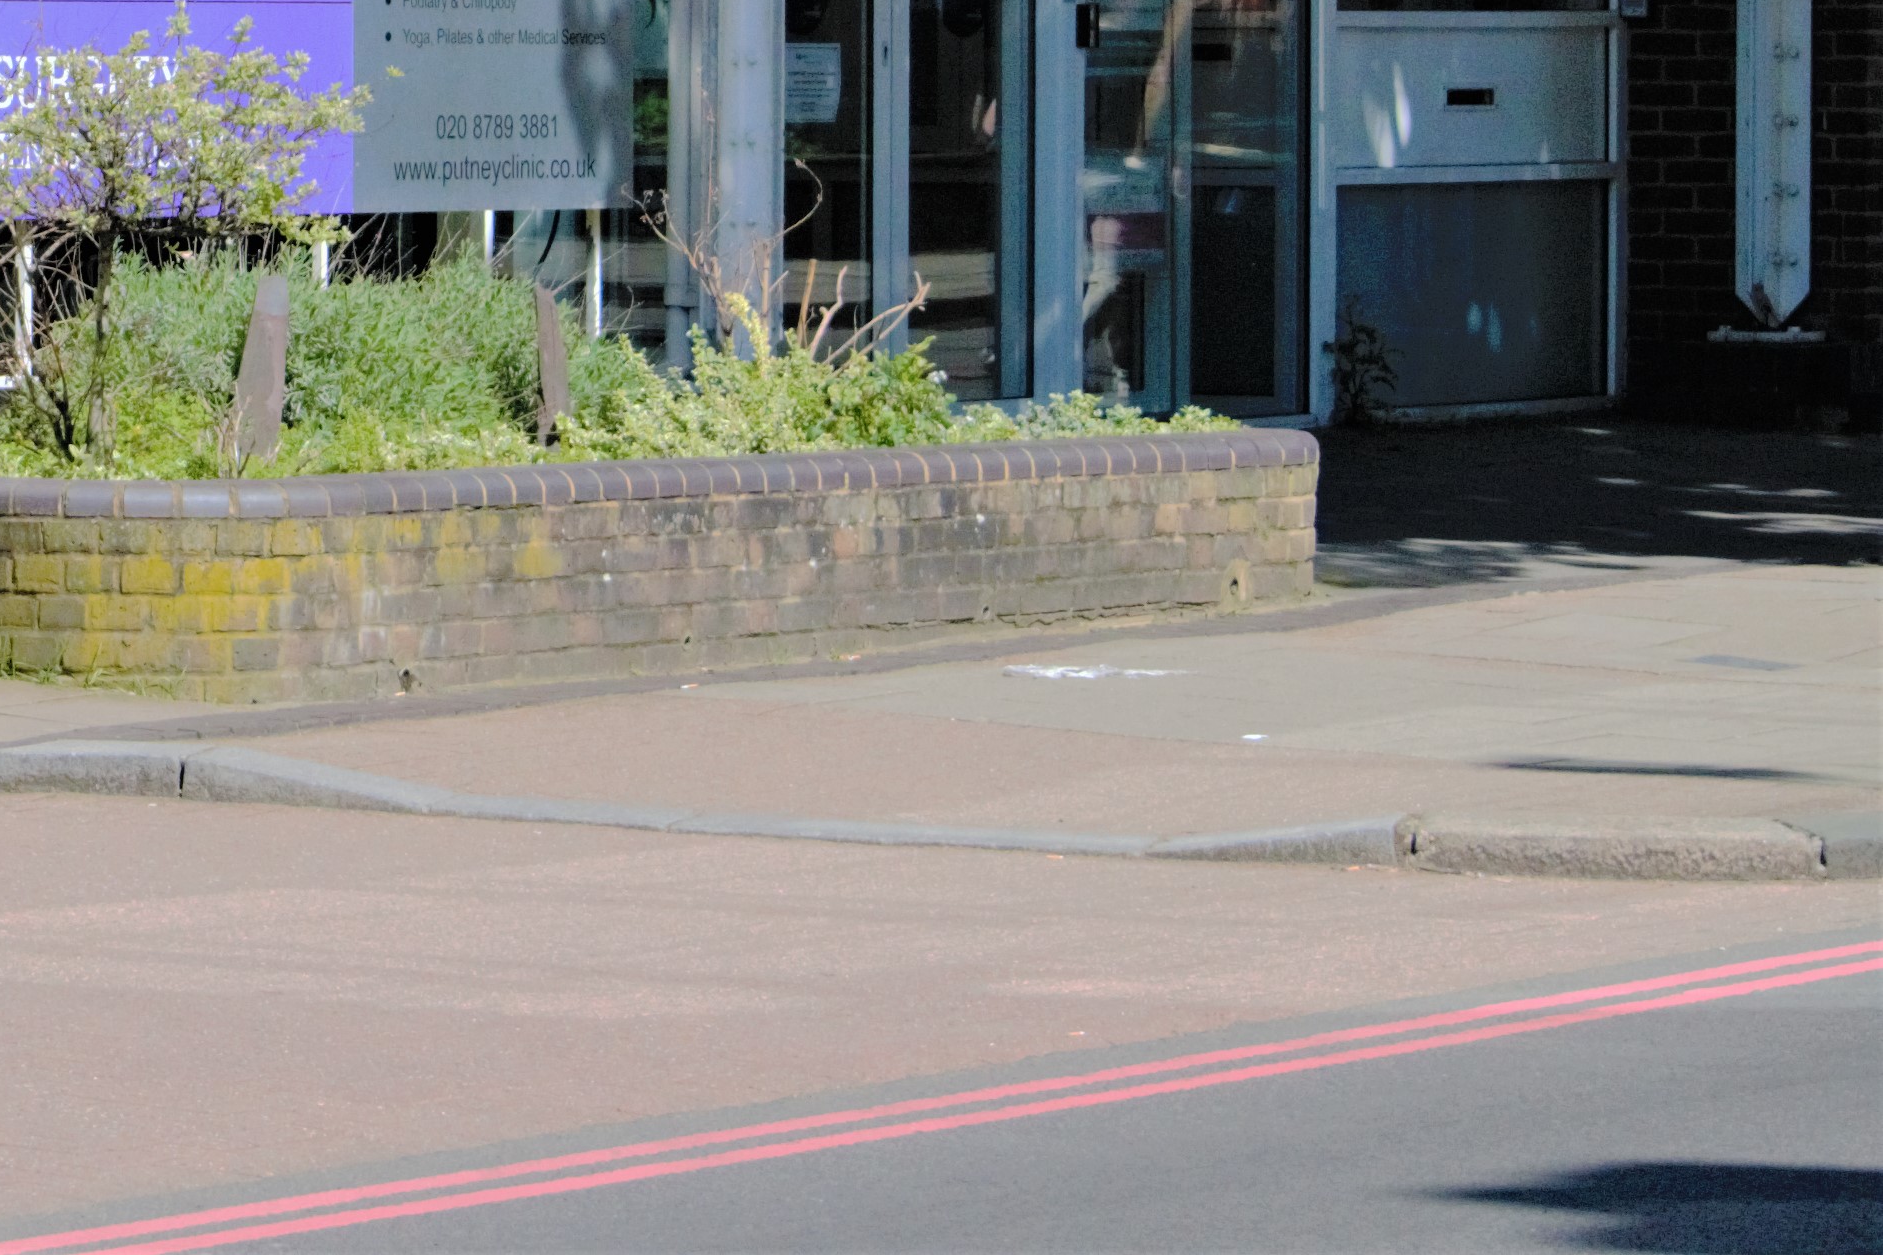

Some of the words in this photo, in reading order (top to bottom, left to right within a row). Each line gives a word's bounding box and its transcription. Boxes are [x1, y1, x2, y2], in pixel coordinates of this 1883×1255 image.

[437, 28, 473, 45] Pilates
[476, 29, 484, 45] &
[488, 29, 517, 45] other
[518, 29, 559, 45] Medical
[562, 29, 606, 45] Services
[436, 114, 467, 140] 020
[473, 114, 514, 140] 8789
[519, 114, 558, 139] 3881
[393, 153, 597, 186] www.putneyclinic.co.uk
